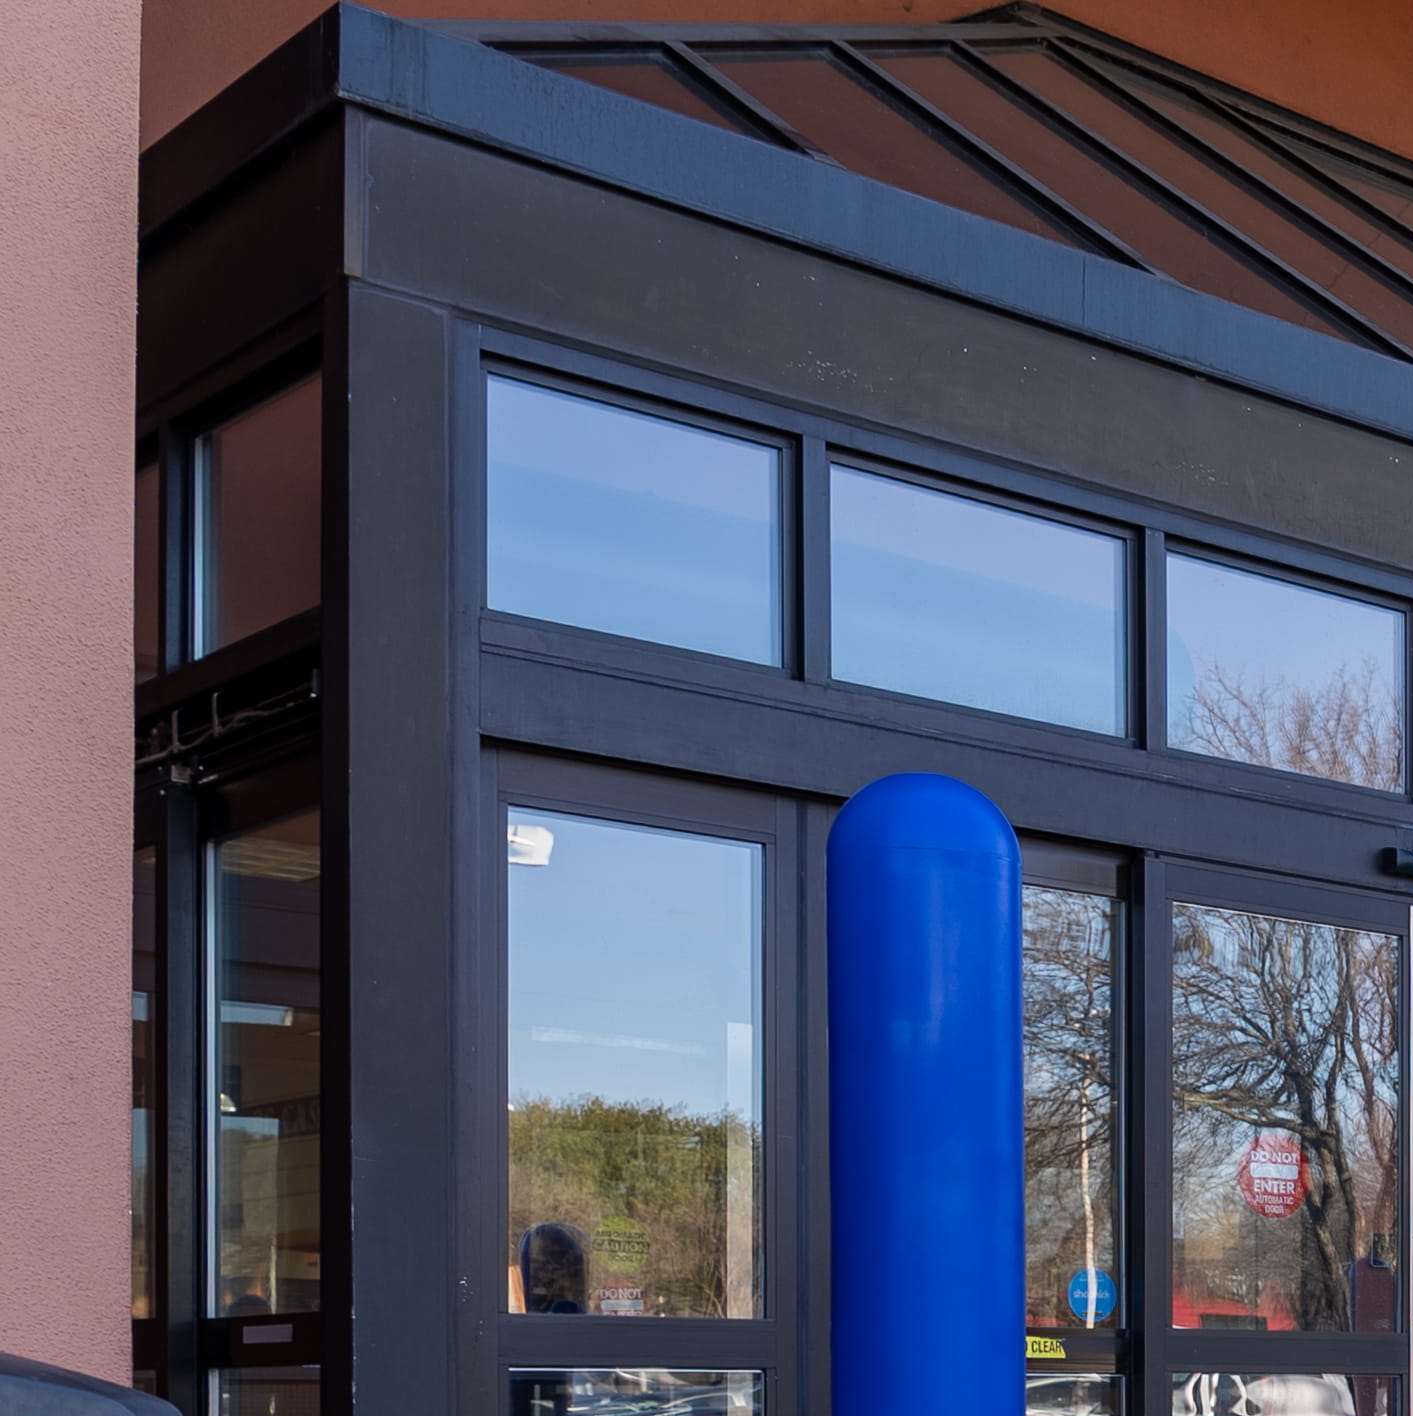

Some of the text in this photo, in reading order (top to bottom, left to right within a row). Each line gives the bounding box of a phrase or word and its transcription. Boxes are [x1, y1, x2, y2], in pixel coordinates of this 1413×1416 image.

[1251, 1151, 1297, 1163] DO NOT
[1254, 1180, 1295, 1194] ENTER
[1255, 1195, 1294, 1205] AUTOMATIC
[594, 1241, 649, 1253] CAUTION
[600, 1288, 642, 1299] DO NOT
[1031, 1341, 1062, 1353] CLEAR
